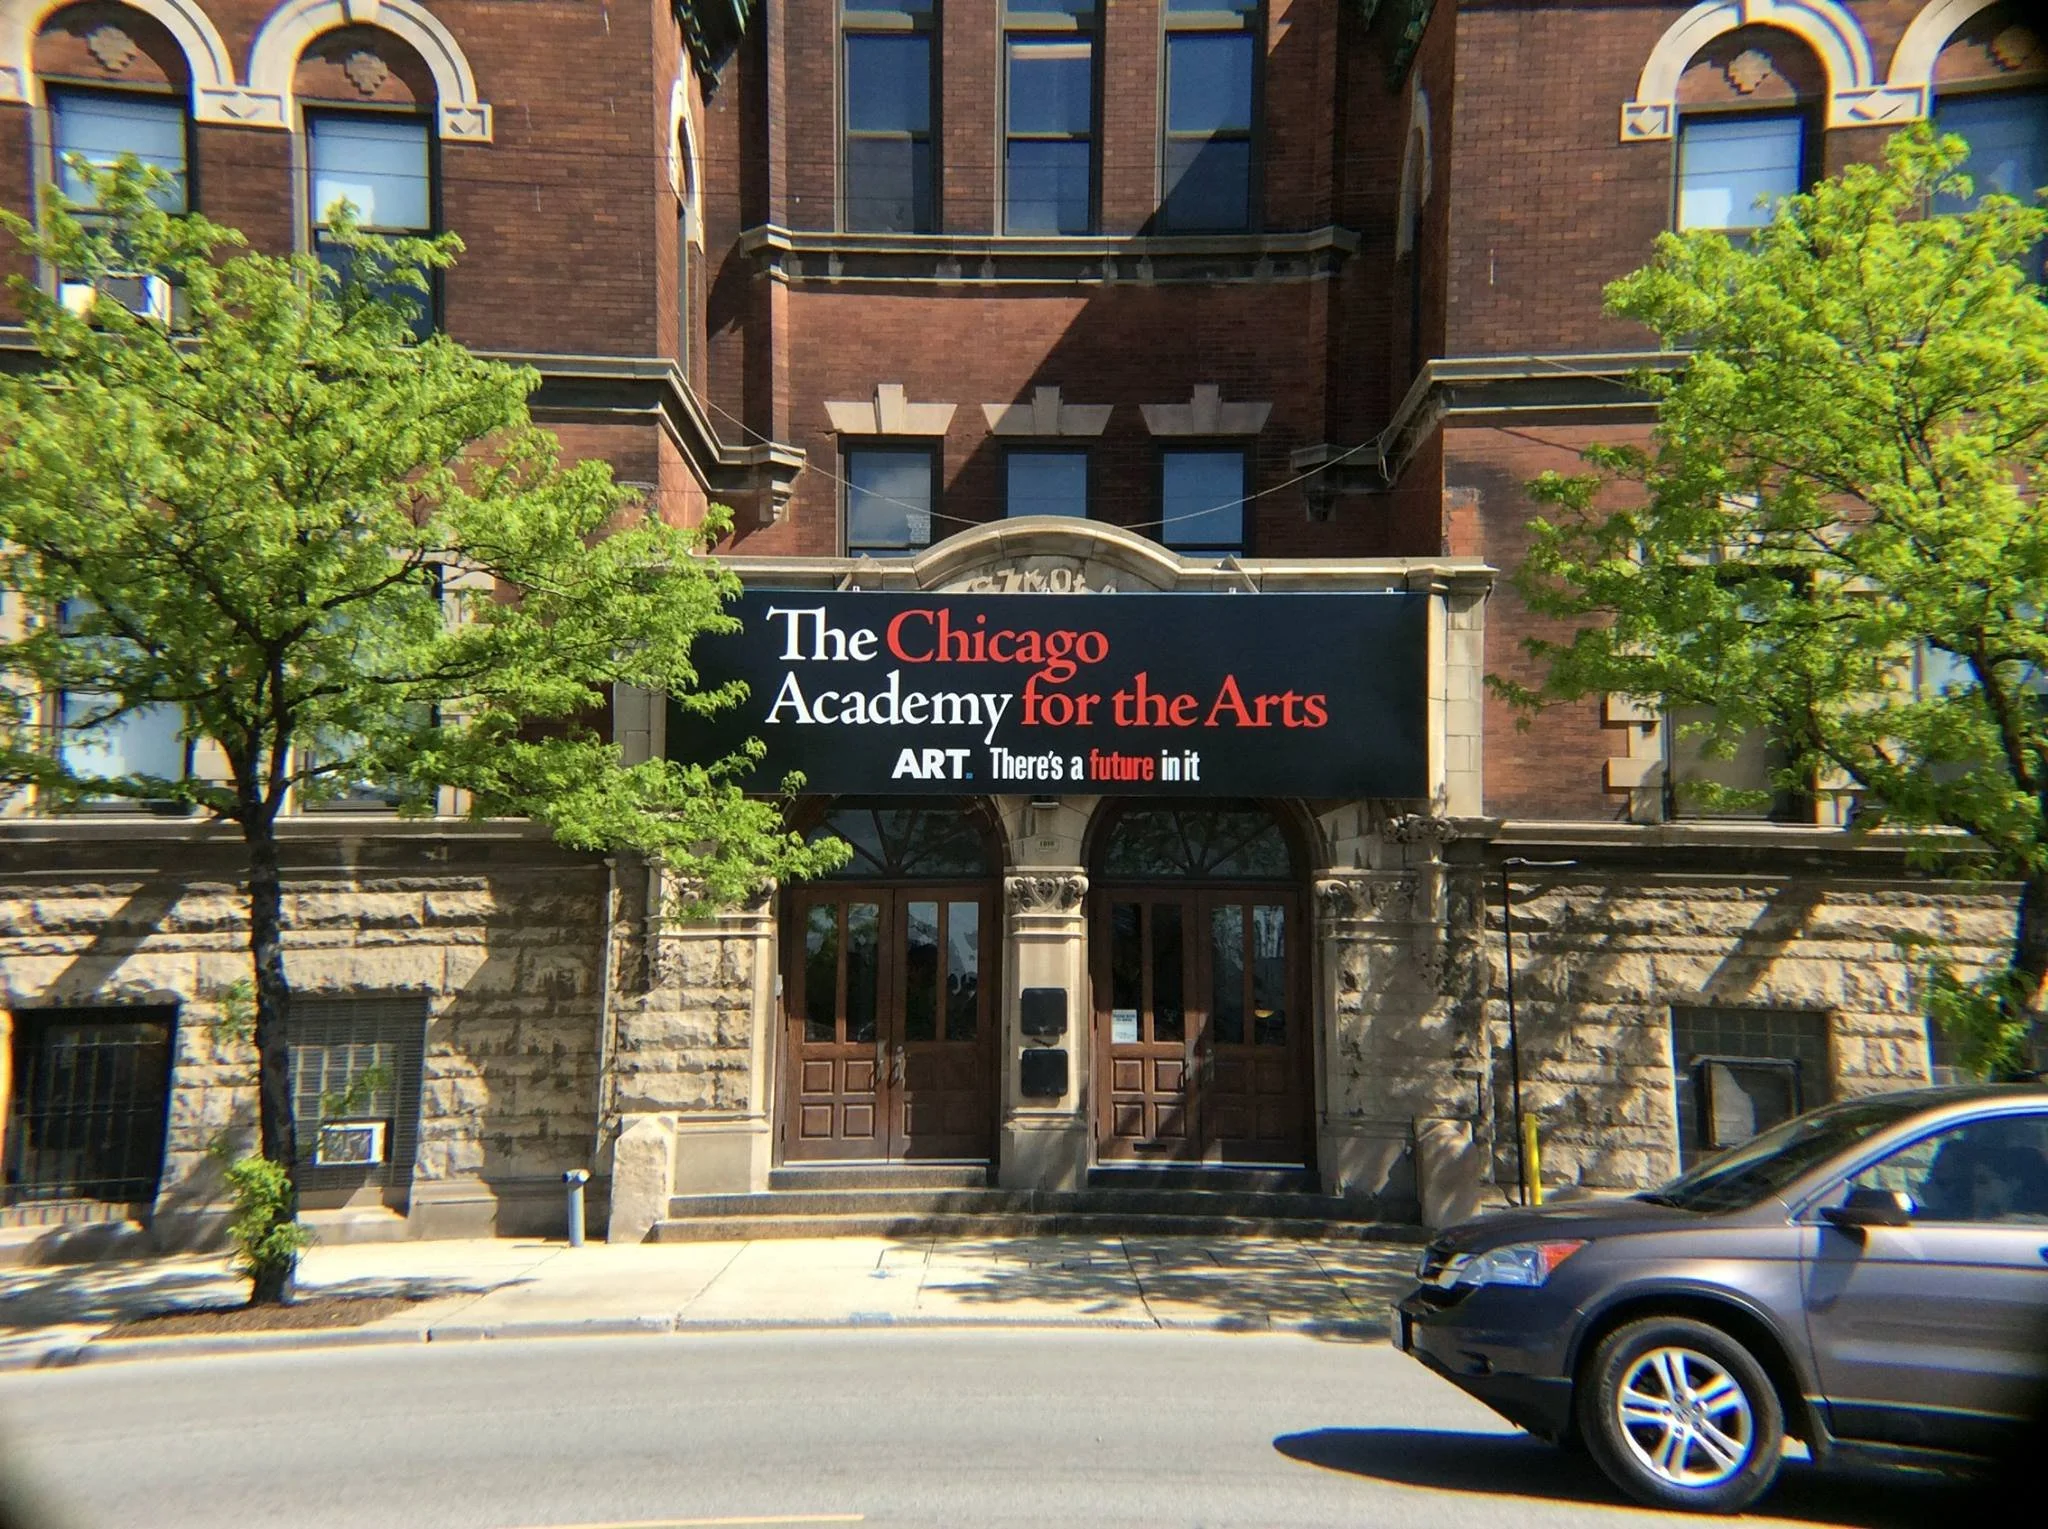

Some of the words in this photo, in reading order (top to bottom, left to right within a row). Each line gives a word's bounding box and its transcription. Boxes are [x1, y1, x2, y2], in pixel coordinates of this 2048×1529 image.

[766, 605, 878, 662] The
[886, 609, 1109, 683] Chicago
[765, 670, 1014, 746] Academy
[1021, 671, 1101, 727] for
[1112, 671, 1199, 727] the
[1204, 674, 1328, 728] Arts
[990, 747, 1063, 781] There's
[1070, 755, 1085, 781] a
[1089, 748, 1154, 781] future
[1161, 749, 1180, 781] in
[1184, 749, 1200, 781] it
